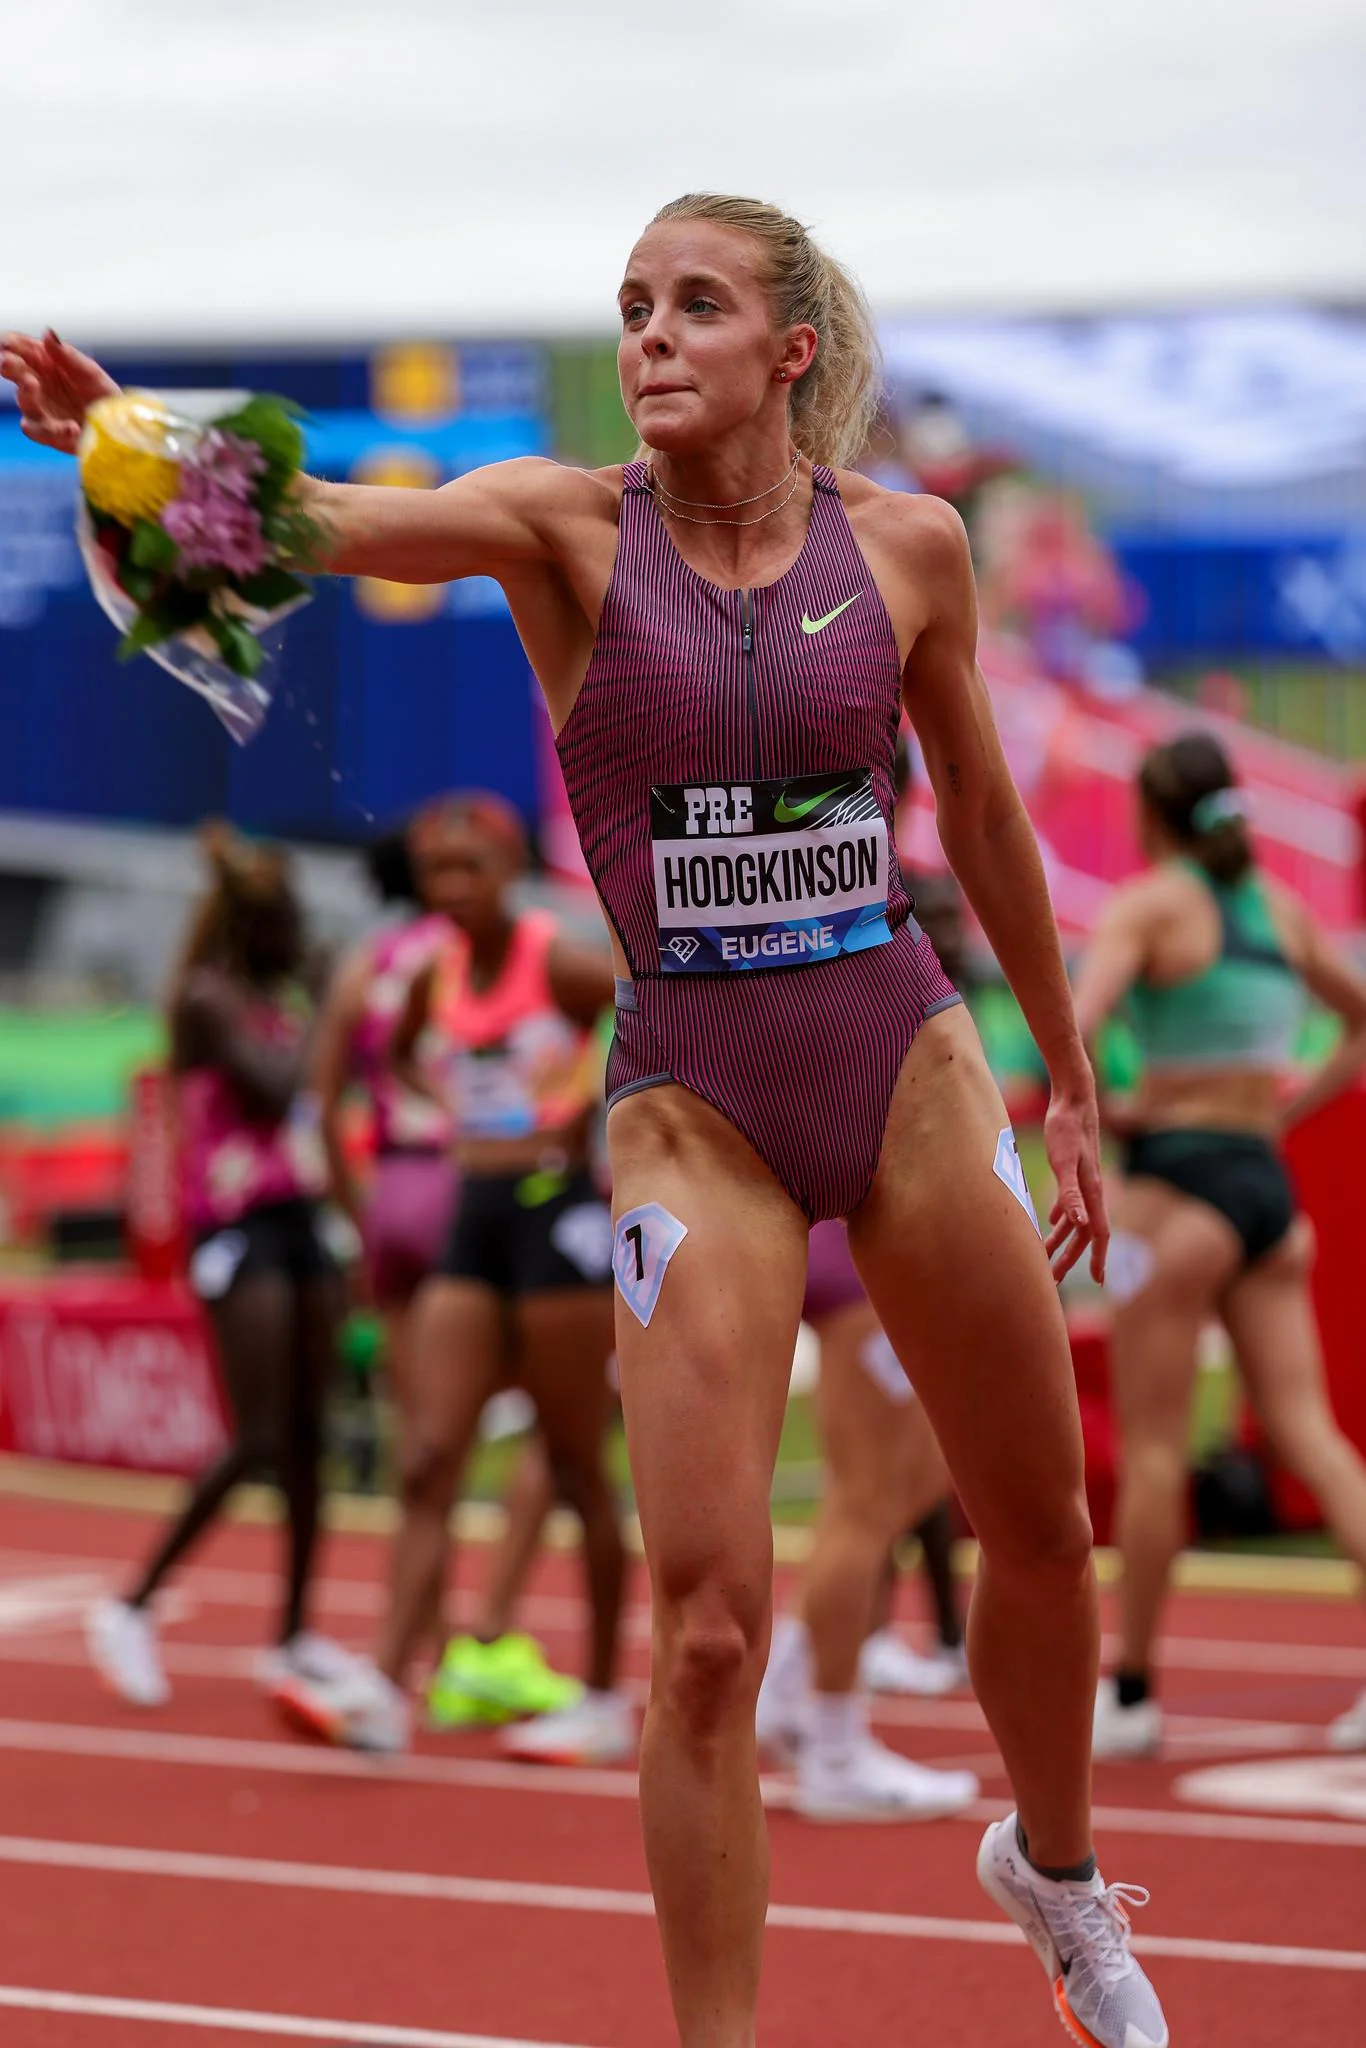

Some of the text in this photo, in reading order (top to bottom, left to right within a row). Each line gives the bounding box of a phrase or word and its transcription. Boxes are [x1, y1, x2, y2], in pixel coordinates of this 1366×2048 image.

[684, 787, 753, 835] PRE
[664, 836, 877, 908] HODGKINSON
[721, 925, 834, 960] EUGENE
[625, 1223, 645, 1282] 1
